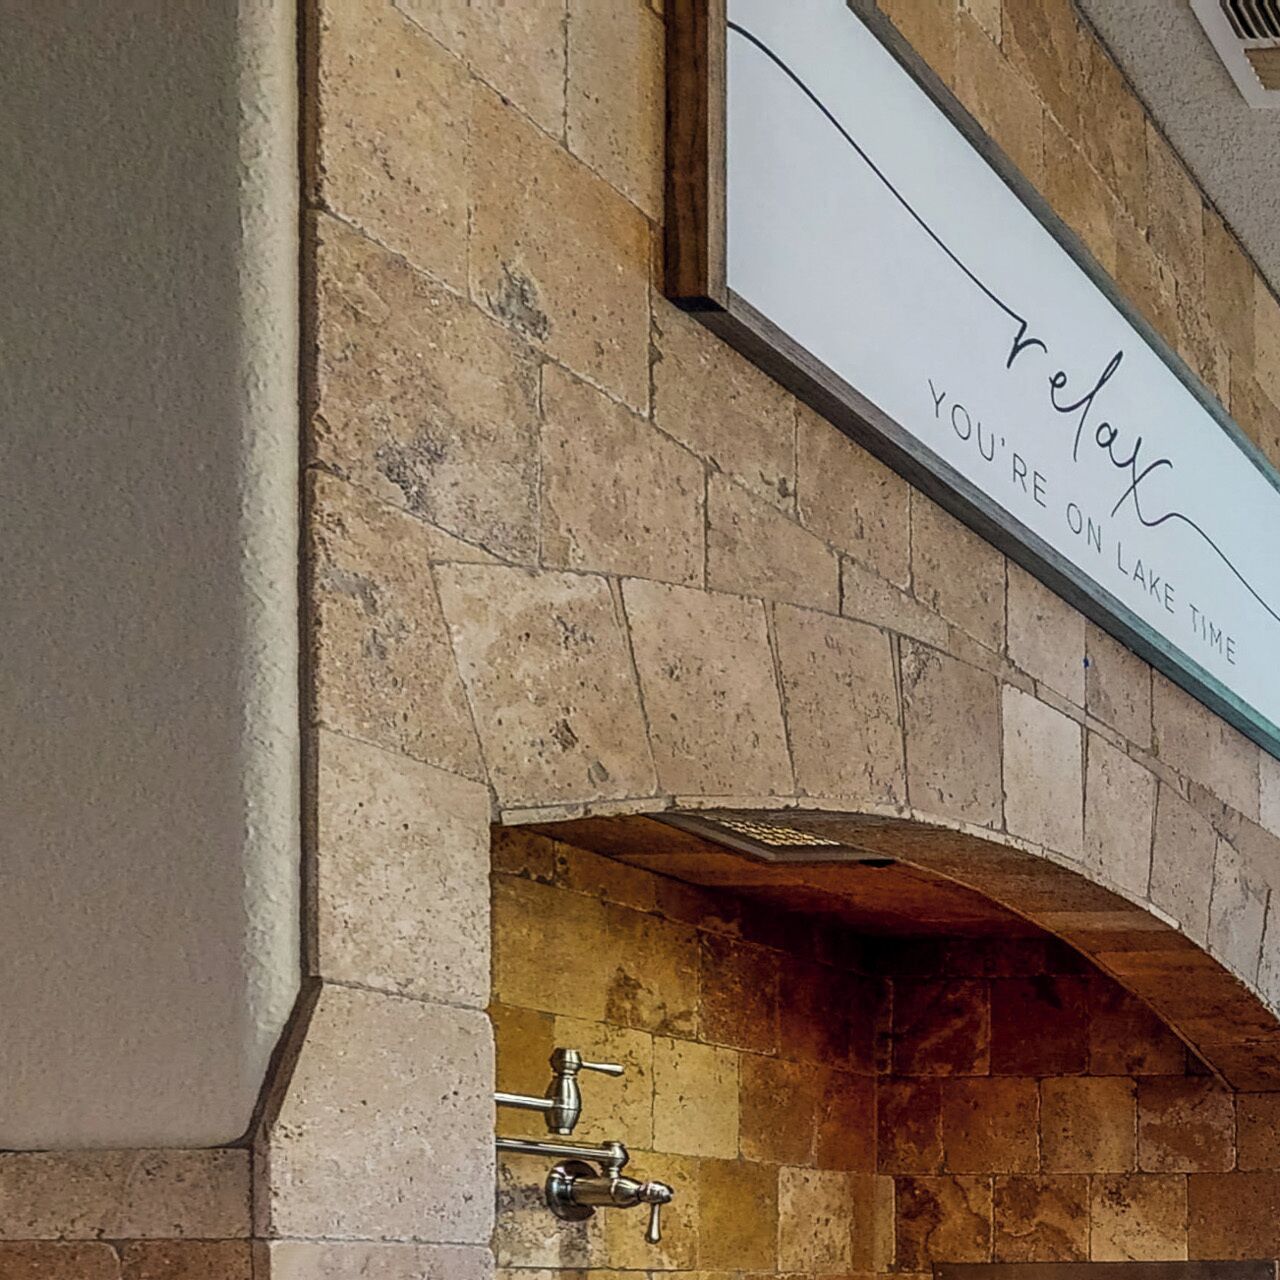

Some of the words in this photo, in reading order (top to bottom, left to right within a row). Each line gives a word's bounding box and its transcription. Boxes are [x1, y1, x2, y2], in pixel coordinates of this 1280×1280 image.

[927, 377, 1047, 509] YOU'RE
[1066, 502, 1102, 554] ON
[1117, 541, 1175, 614] LAKE
[1188, 602, 1237, 666] TIME
